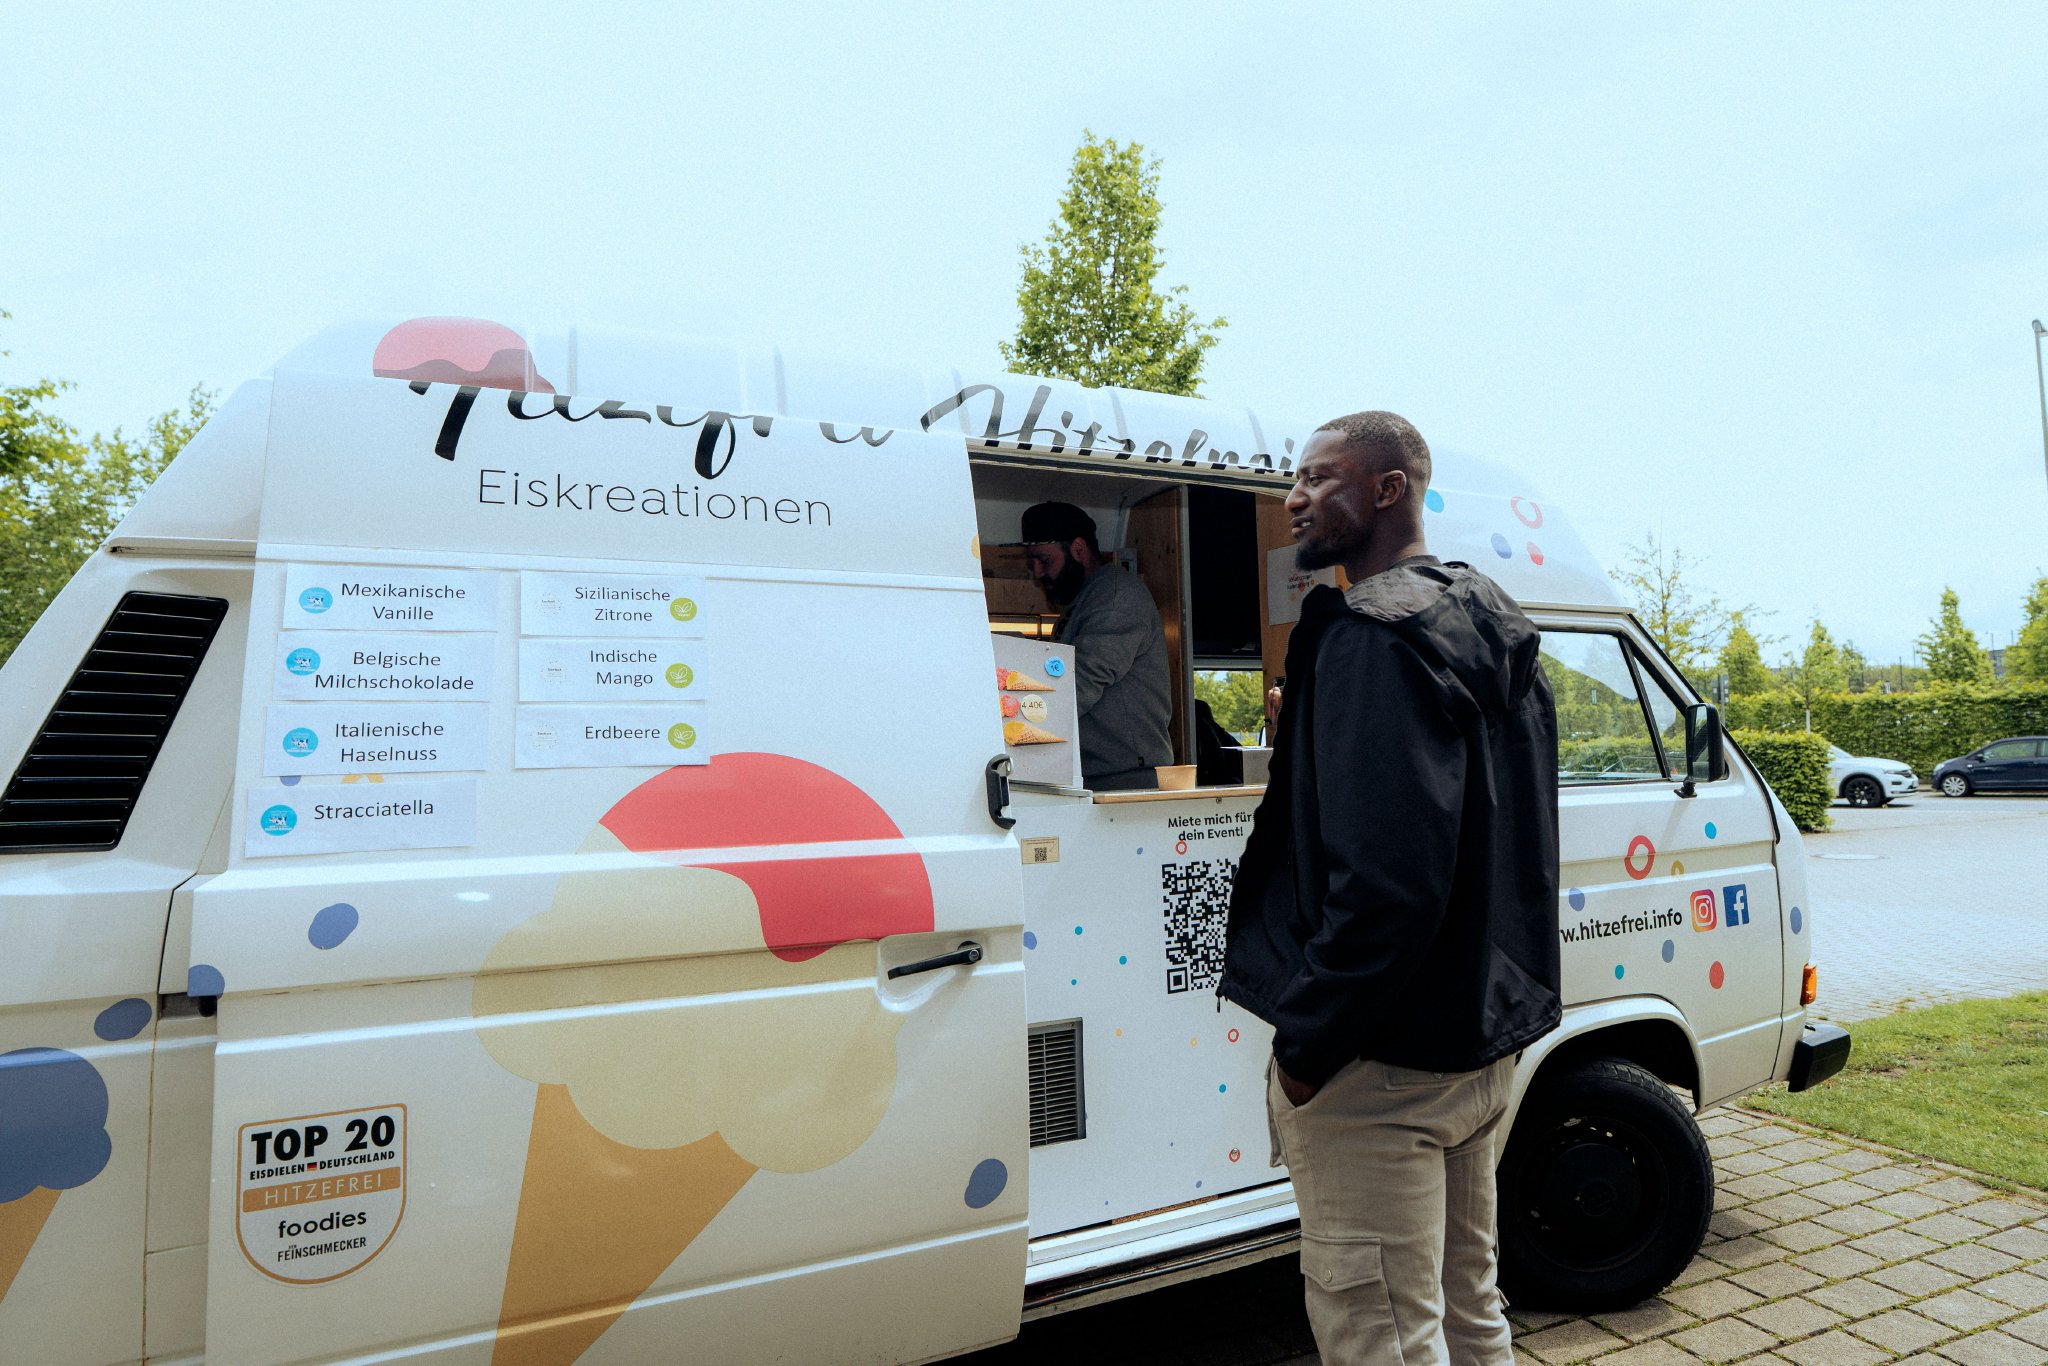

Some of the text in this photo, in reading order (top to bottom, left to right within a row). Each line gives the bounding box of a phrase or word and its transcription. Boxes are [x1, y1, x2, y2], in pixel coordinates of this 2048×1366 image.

[479, 469, 831, 527] Eiskreationen
[341, 583, 466, 600] Mexikanische
[575, 586, 671, 602] Sizilianische
[372, 606, 434, 621] Vanille
[594, 607, 653, 622] Zitrone
[353, 651, 441, 669] Belgische
[590, 649, 657, 664] Indische
[315, 674, 474, 691] Milchschokolade
[596, 671, 653, 688] Mango
[335, 721, 444, 739] Italienische
[584, 725, 661, 741] Erdbeere
[341, 746, 437, 763] Haselnuss
[314, 800, 434, 821] Stracciatella
[1168, 812, 1252, 828] Miete mich für
[1178, 826, 1244, 841] dein Event!
[251, 1115, 396, 1165] TOP 20
[249, 1150, 396, 1181] EISDIELEN DEUTSCHLAND
[264, 1173, 382, 1206] HITZEFREI
[278, 1211, 367, 1239] foodies
[277, 1236, 367, 1263] FEINSCHMECKER
